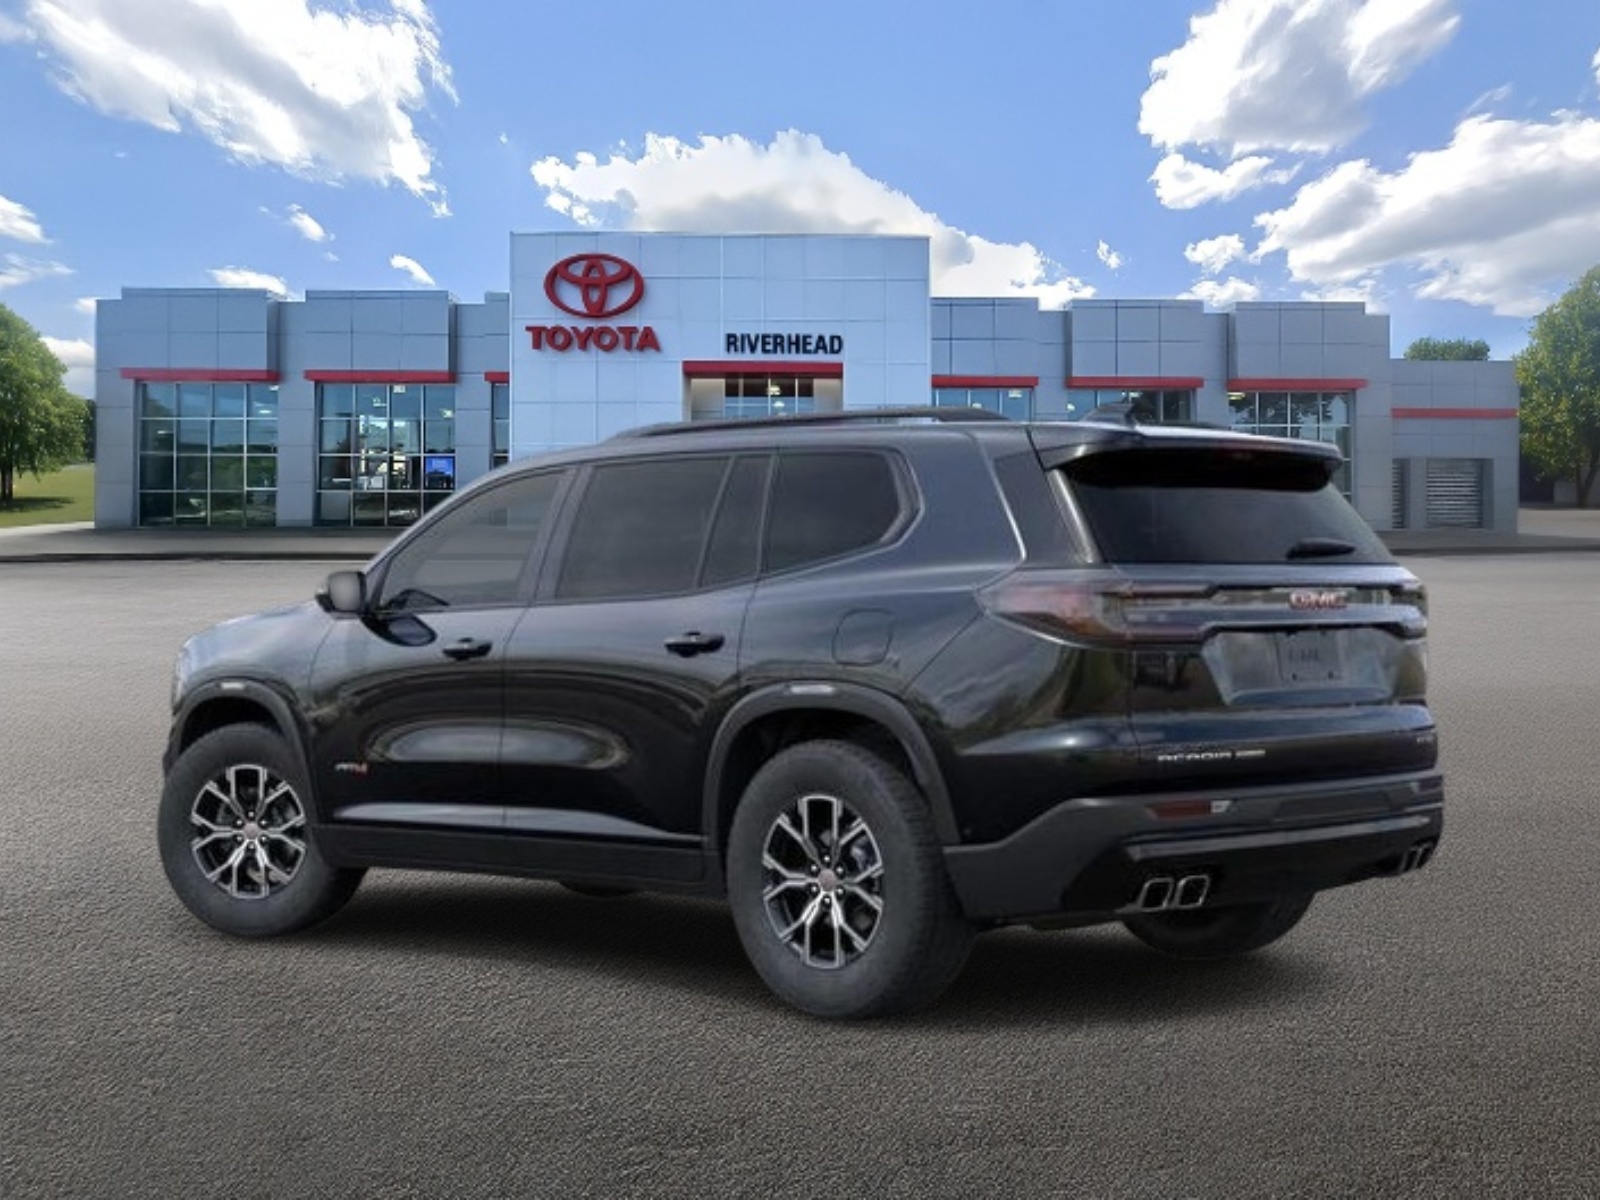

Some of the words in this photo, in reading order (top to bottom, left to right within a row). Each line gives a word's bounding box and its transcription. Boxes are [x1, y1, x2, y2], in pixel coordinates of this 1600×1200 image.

[525, 326, 661, 353] TOYOTA
[725, 333, 844, 355] RIVERHEAD
[1289, 590, 1348, 609] GMC
